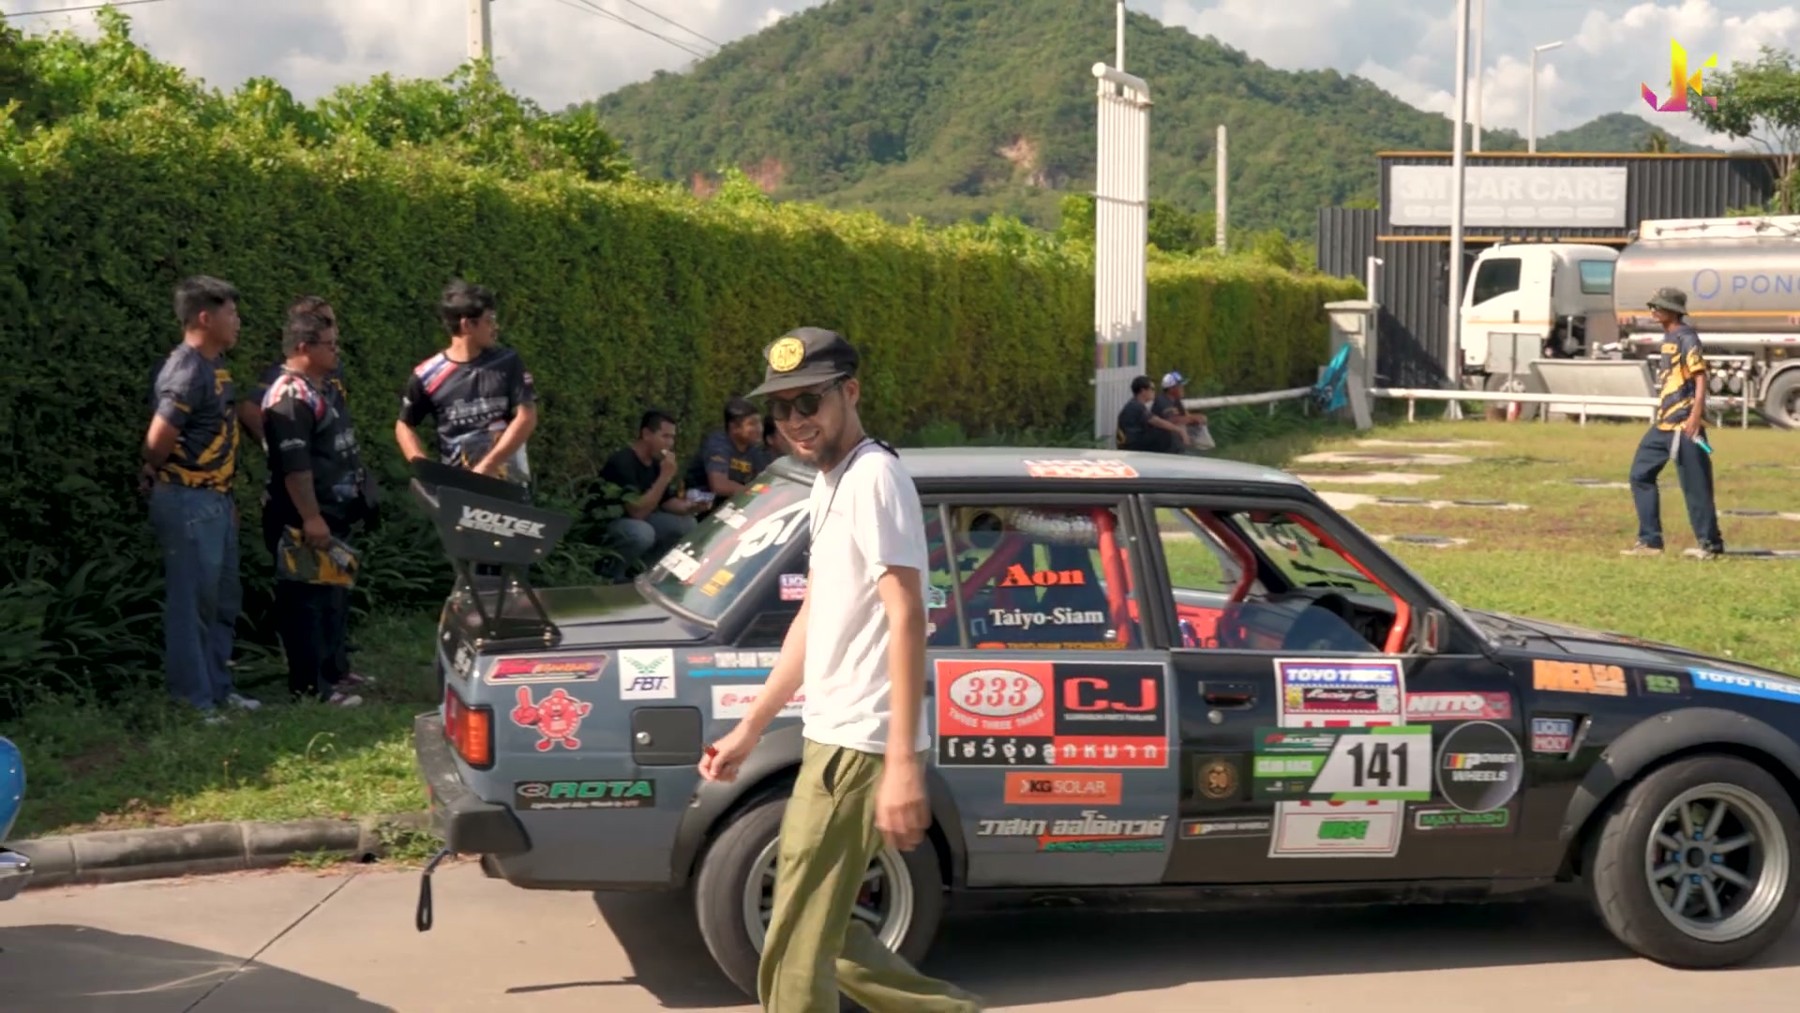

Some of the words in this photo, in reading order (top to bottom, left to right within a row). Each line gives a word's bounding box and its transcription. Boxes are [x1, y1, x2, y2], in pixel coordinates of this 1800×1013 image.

[1528, 175, 1619, 202] CARE
[1732, 274, 1800, 295] PON
[462, 505, 546, 539] VOLTEK
[999, 563, 1085, 587] Aon
[989, 607, 1105, 630] Taiyo-Siam
[624, 675, 670, 692] FBT
[1286, 668, 1337, 682] TOYO
[1698, 671, 1751, 687] TOYO
[965, 677, 1030, 707] 333
[1064, 677, 1158, 712] CJ
[1407, 695, 1485, 711] NITTO
[1534, 736, 1569, 750] MOLY
[1347, 742, 1409, 787] 141
[1464, 753, 1517, 769] POWER
[1452, 770, 1509, 781] WHEELS
[549, 781, 652, 798] ROTA
[1053, 780, 1106, 793] SOLAR
